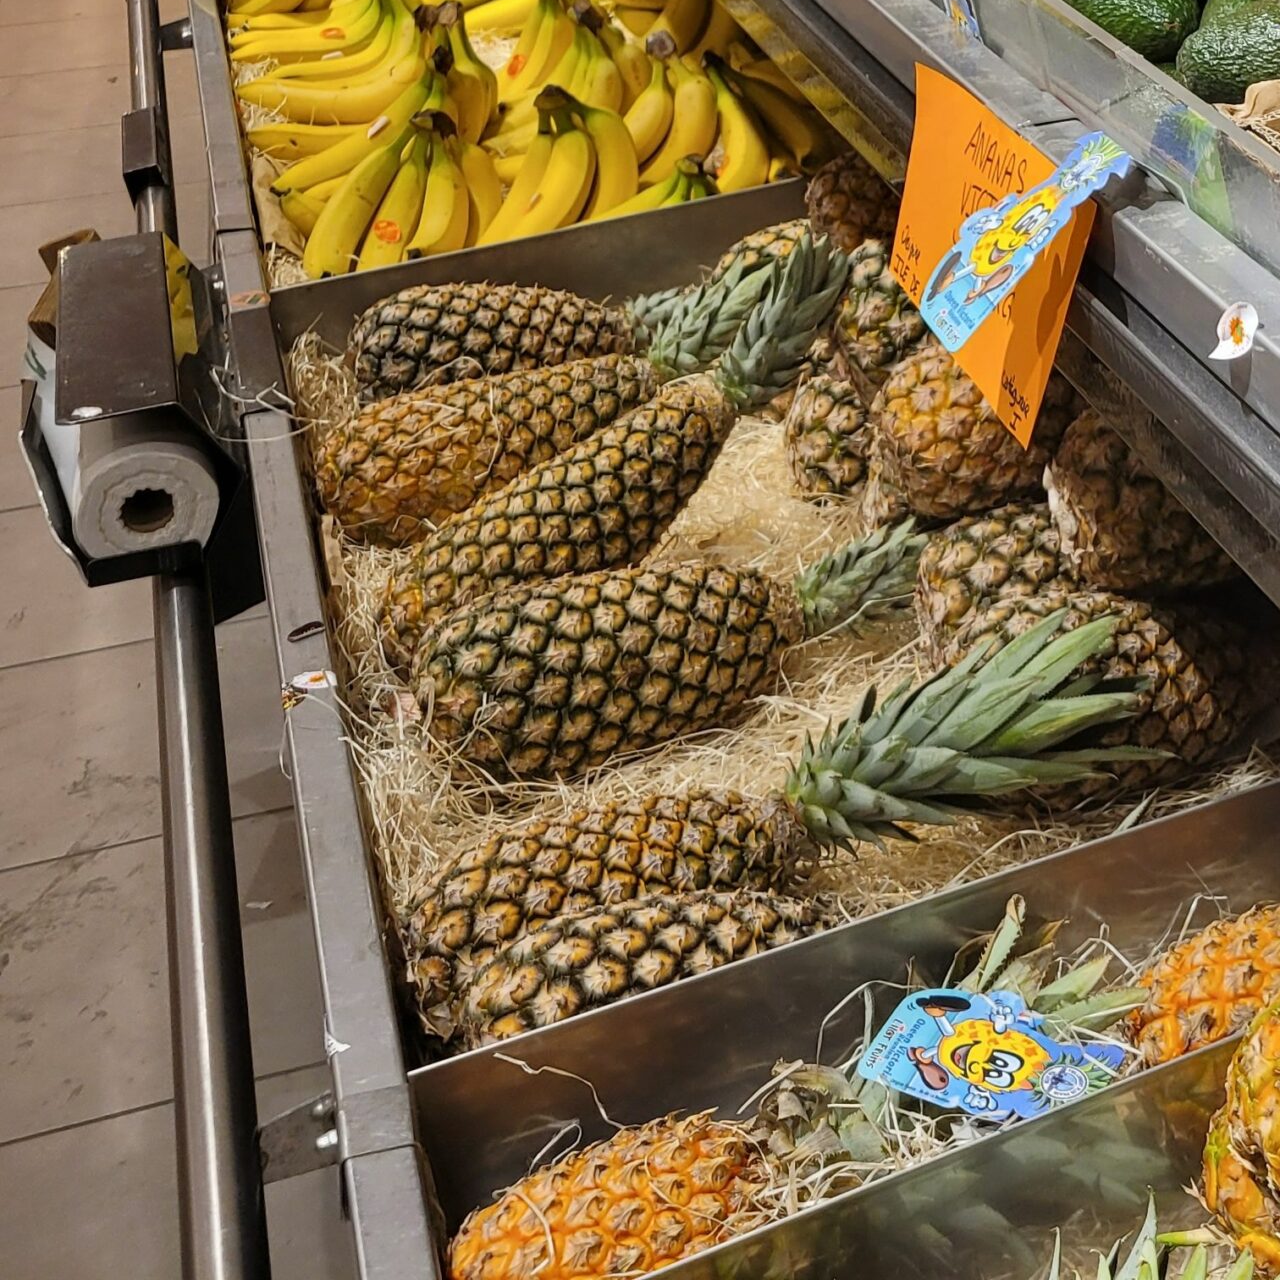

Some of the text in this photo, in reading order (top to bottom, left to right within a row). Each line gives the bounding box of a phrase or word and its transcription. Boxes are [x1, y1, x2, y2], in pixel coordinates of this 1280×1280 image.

[964, 121, 1027, 194] ANANAS
[909, 273, 921, 297] DE
[903, 1018, 926, 1044] Queen
